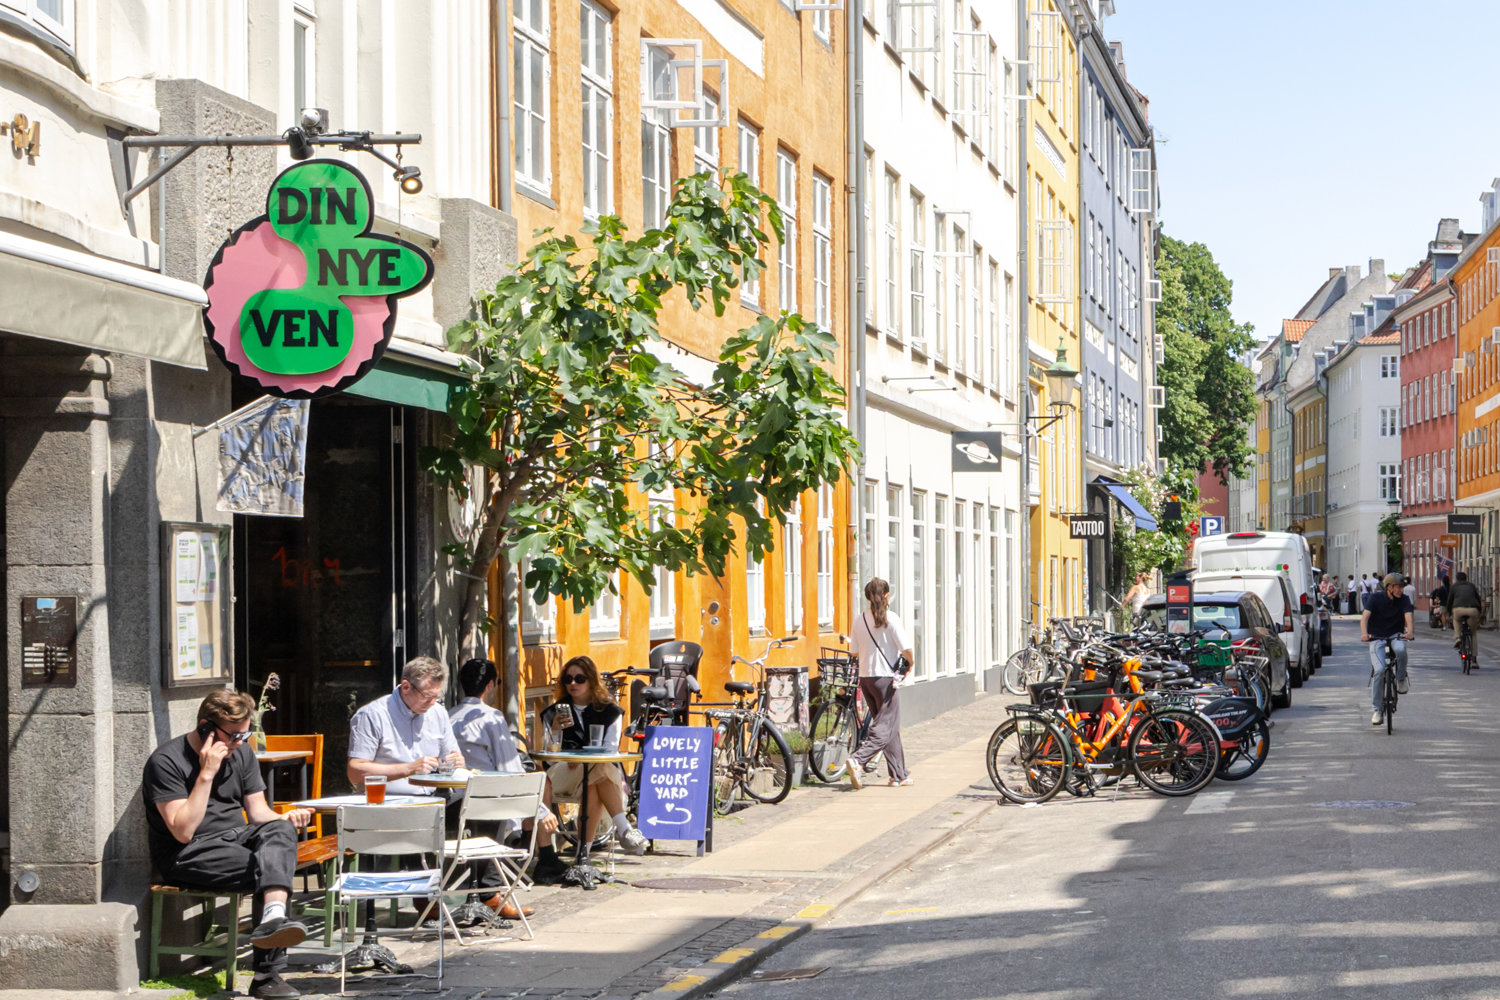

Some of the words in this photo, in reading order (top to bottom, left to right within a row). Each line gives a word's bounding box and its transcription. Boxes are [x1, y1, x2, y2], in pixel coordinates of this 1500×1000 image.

[276, 187, 357, 226] DIN
[317, 248, 401, 287] NYE
[249, 309, 339, 348] VEN
[1071, 520, 1105, 536] TATTOO
[1205, 518, 1218, 536] P
[1169, 588, 1176, 597] P
[653, 737, 701, 753] LOVELY
[651, 757, 699, 770] LITTLE
[650, 772, 699, 786] COURT-
[654, 787, 689, 800] YARD
